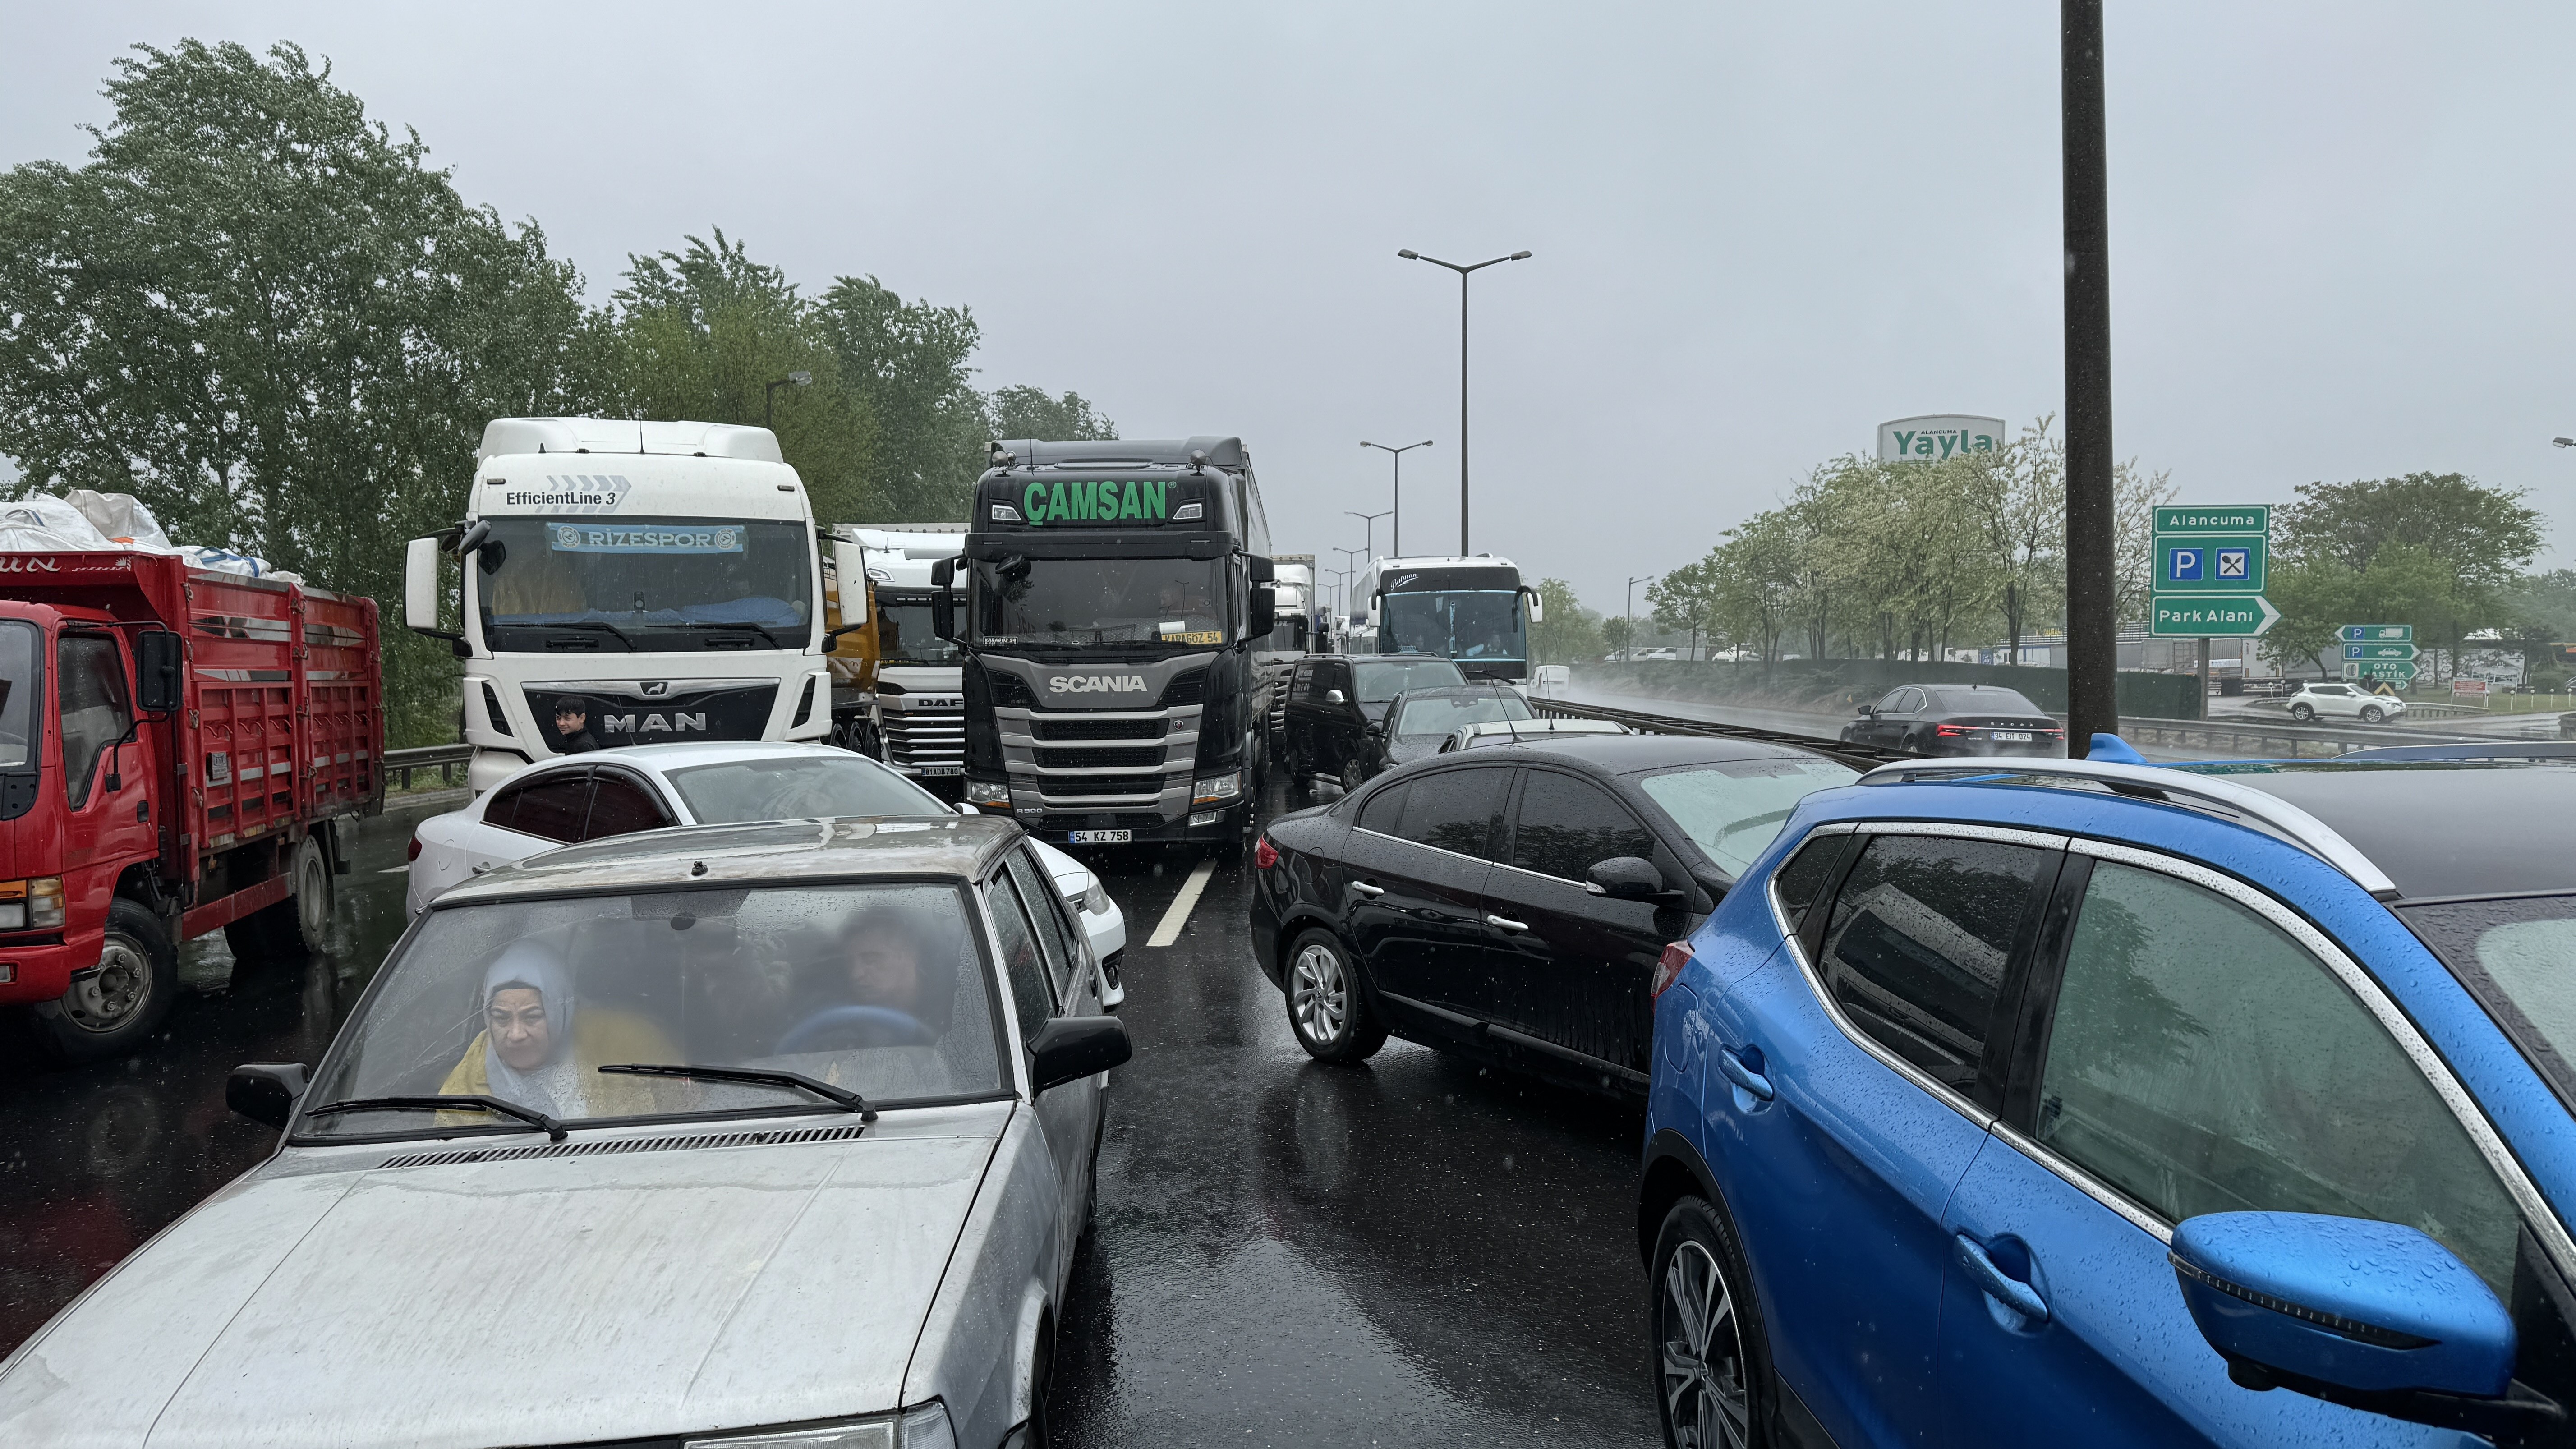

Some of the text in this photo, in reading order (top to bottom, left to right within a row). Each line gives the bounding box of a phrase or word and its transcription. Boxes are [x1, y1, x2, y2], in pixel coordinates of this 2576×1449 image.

[1893, 429, 1992, 459] Yayla
[507, 492, 616, 504] EfficientLine 3
[1024, 481, 1165, 525] ÇAMSAN
[2170, 515, 2254, 525] Alancuma
[589, 528, 711, 547] RİZESPOR
[2176, 552, 2195, 577] P
[2160, 610, 2252, 621] Park Alanı
[1165, 632, 1218, 643] KARAGÖZ 54
[2354, 629, 2362, 638] P
[2352, 647, 2360, 657] P
[1049, 676, 1148, 693] SCANIA
[604, 713, 706, 733] MAN
[1076, 831, 1129, 842] 54 KZ 758
